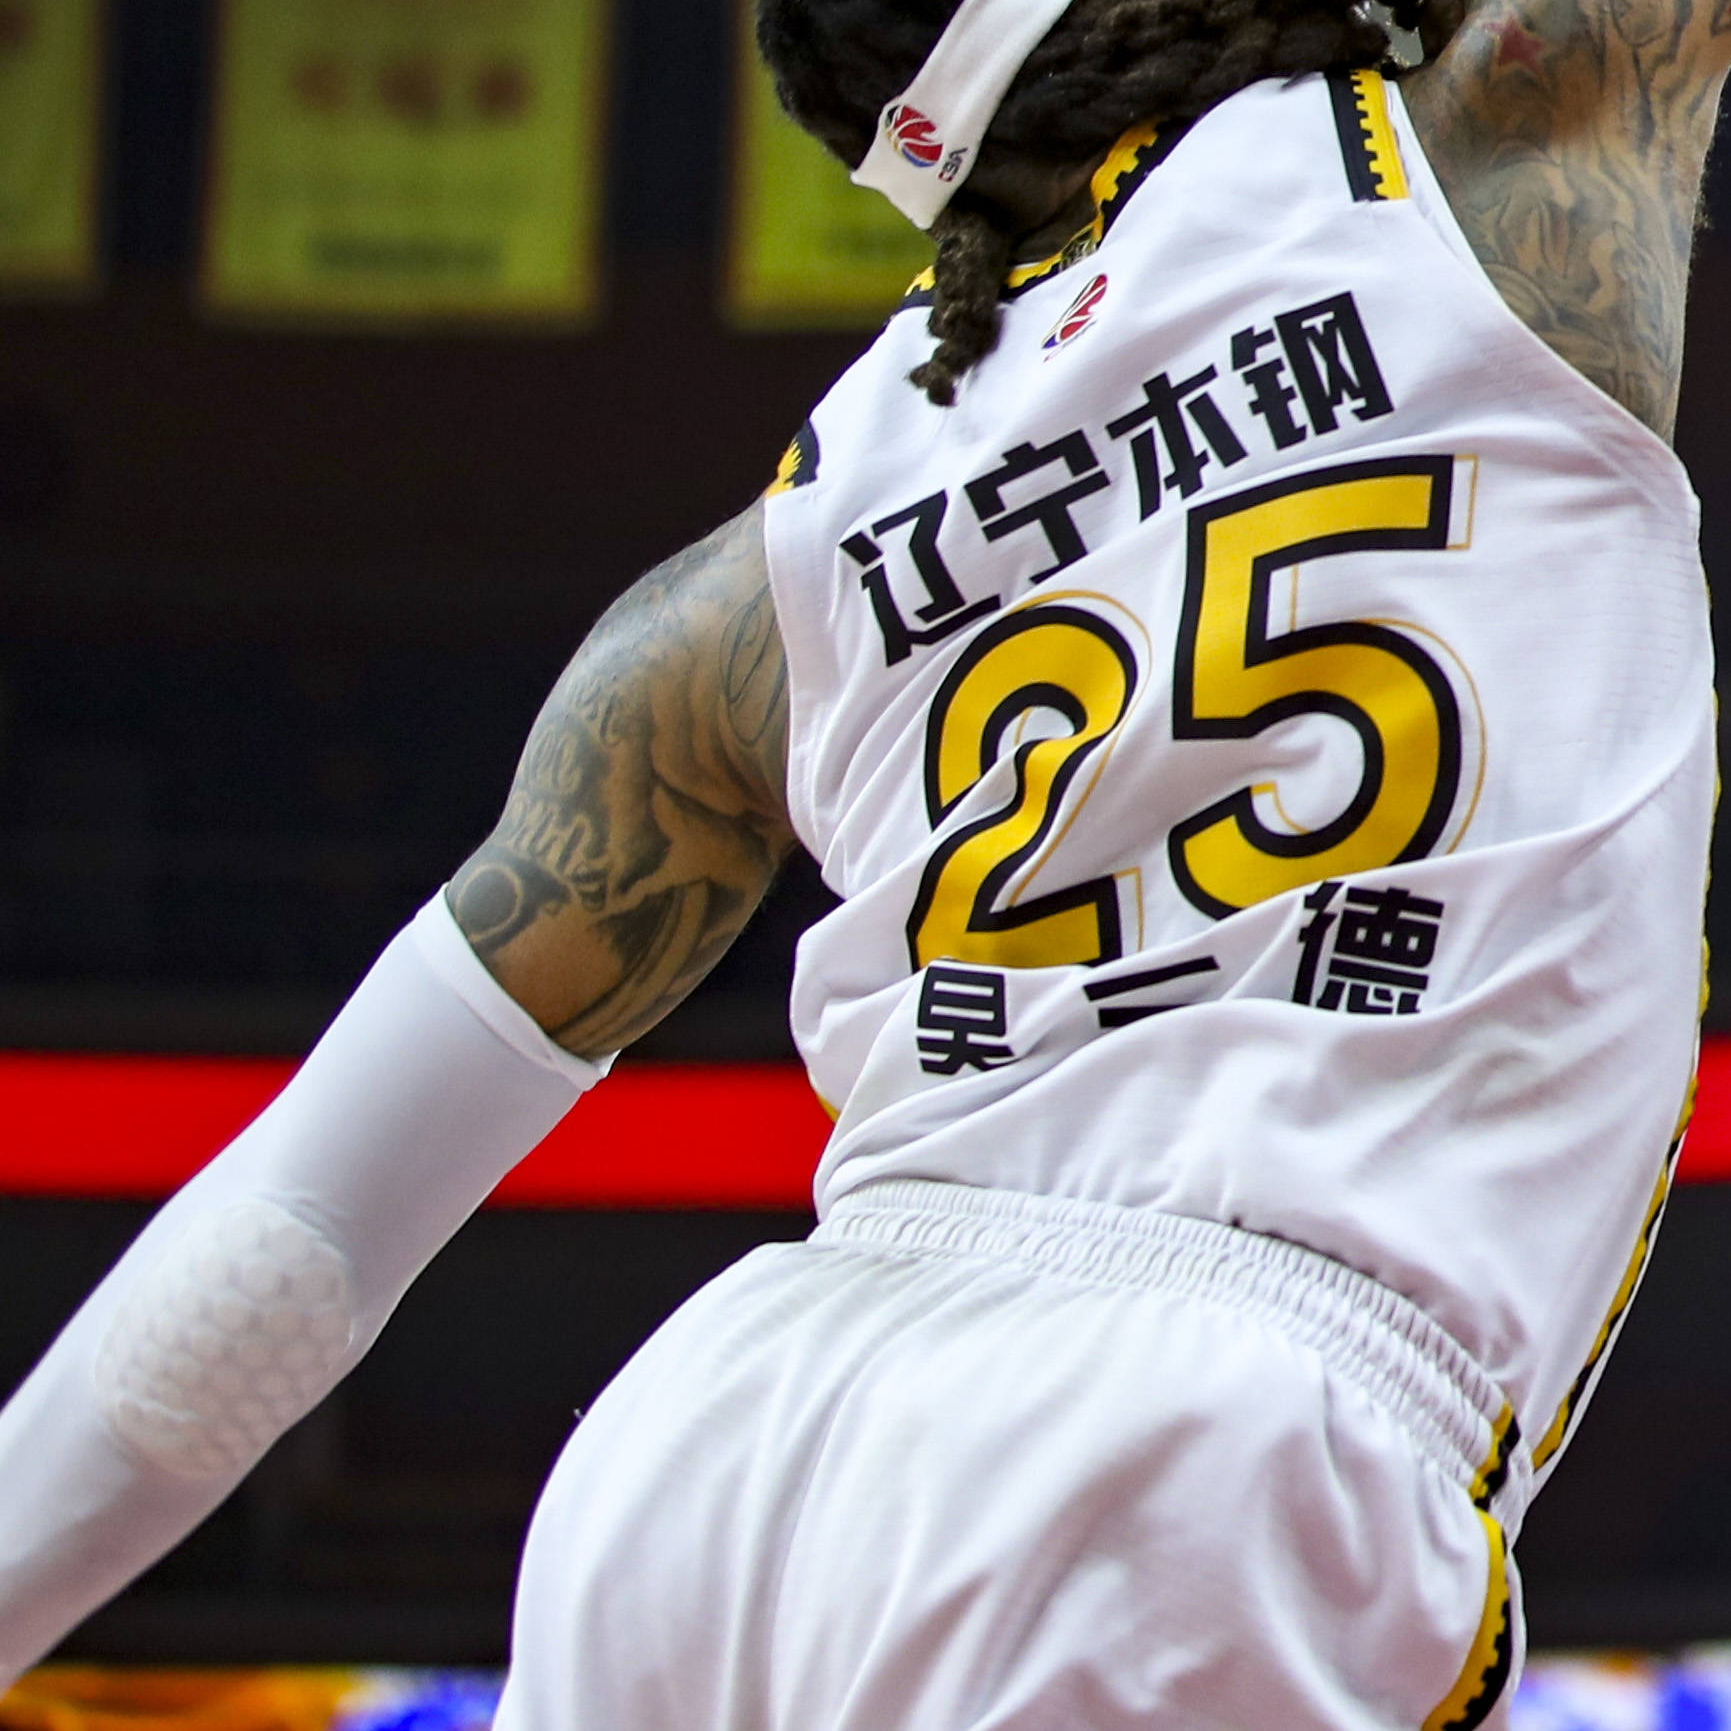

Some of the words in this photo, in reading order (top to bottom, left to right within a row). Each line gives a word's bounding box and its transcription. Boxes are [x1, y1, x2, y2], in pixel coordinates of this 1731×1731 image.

[839, 291, 1393, 667] 辽宁本钢
[904, 455, 1470, 972] 25
